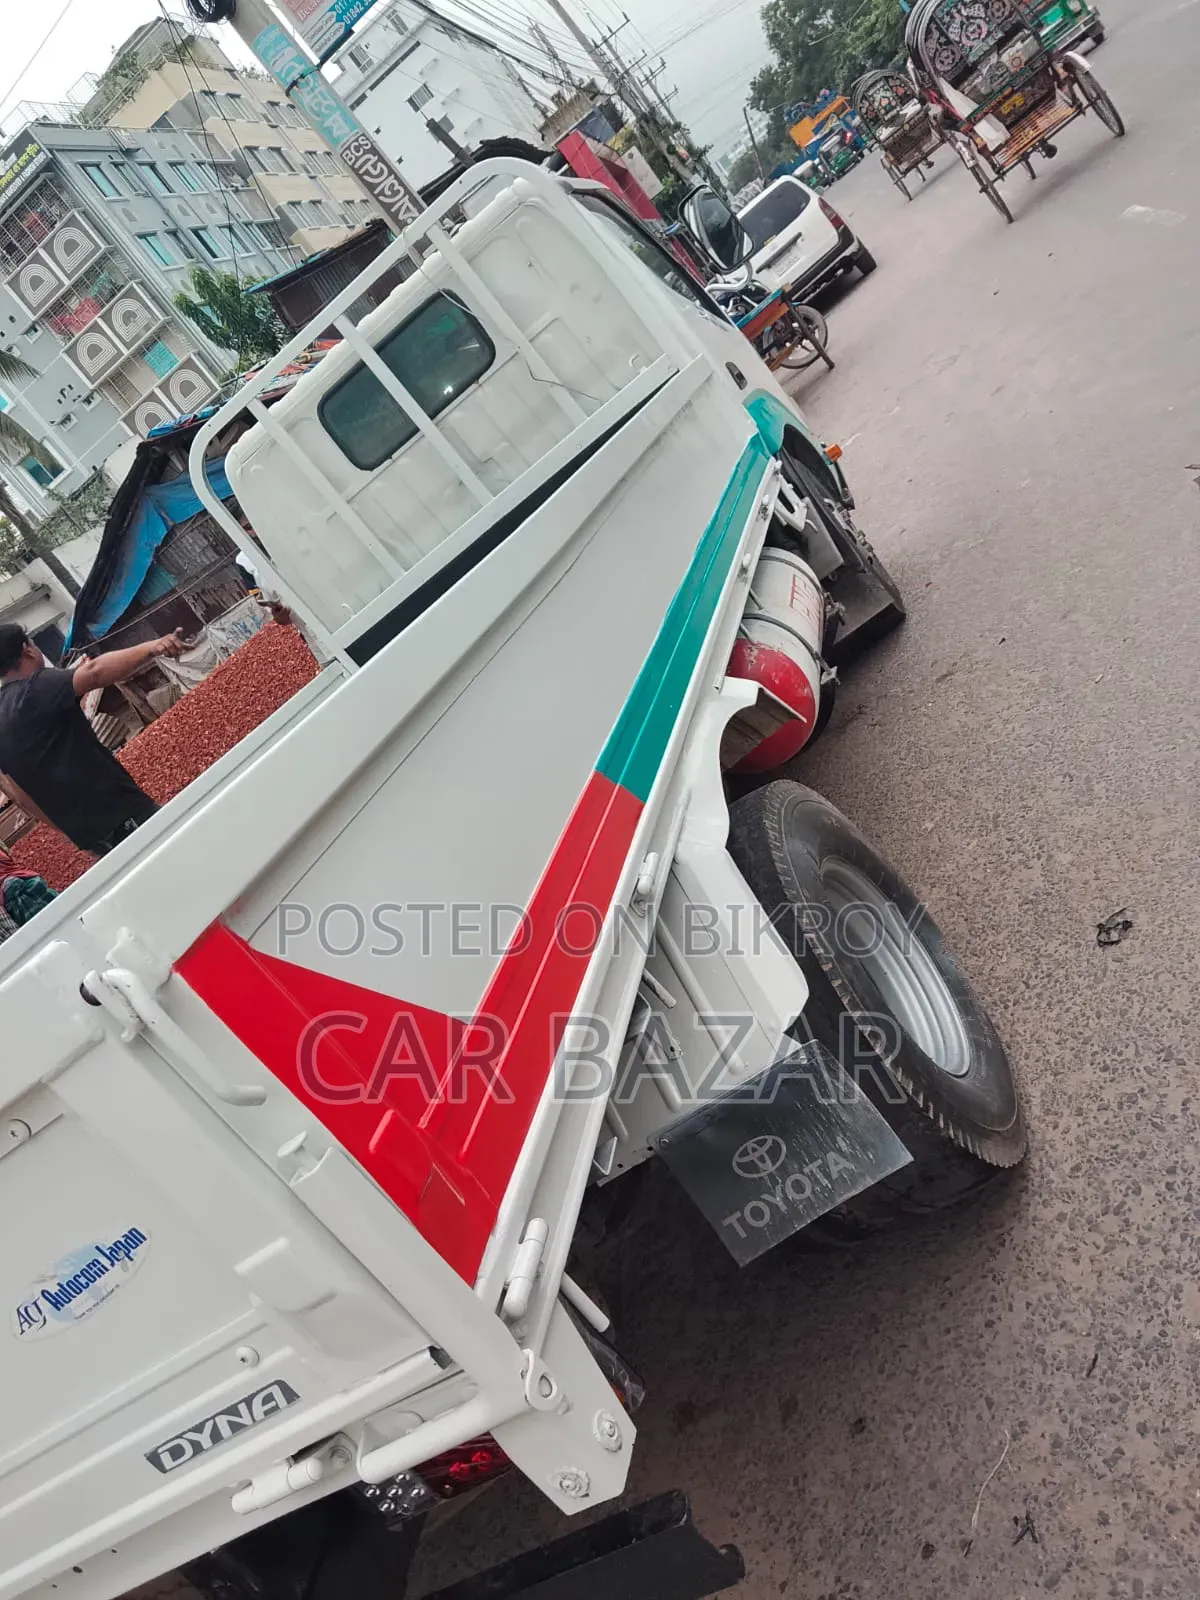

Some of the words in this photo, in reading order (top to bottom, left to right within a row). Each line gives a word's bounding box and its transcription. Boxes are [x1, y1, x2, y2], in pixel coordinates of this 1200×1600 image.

[342, 135, 371, 164] BCS
[721, 1136, 855, 1239] TOYOTA
[40, 1257, 110, 1312] Autocom
[94, 1226, 148, 1268] Japan
[157, 1384, 288, 1471] DYNA
